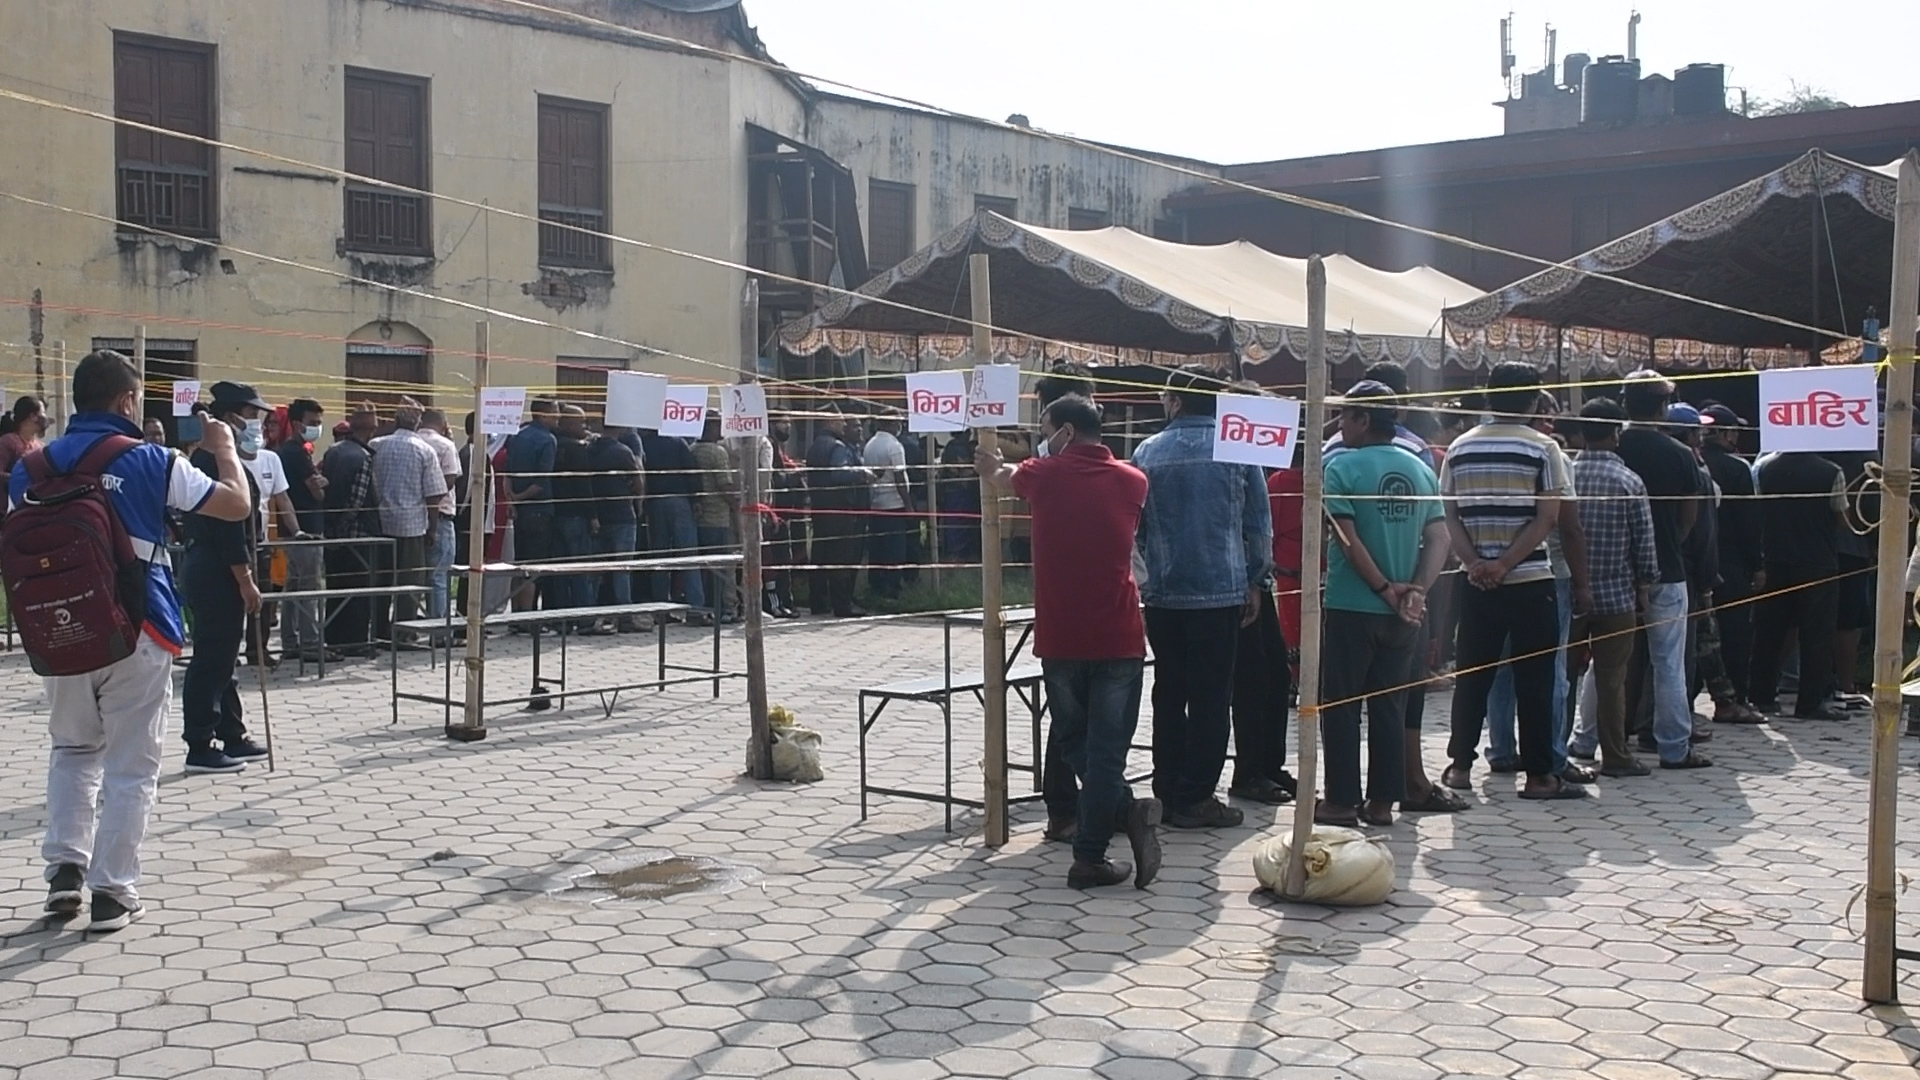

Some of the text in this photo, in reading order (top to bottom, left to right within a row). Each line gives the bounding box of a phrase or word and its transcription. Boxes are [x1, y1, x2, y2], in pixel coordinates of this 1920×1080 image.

[663, 400, 704, 422] भित्र
[913, 390, 963, 415] भित्र
[969, 402, 1007, 418] रूष
[1768, 391, 1872, 428] बाहिर
[1221, 414, 1292, 447] भित्र
